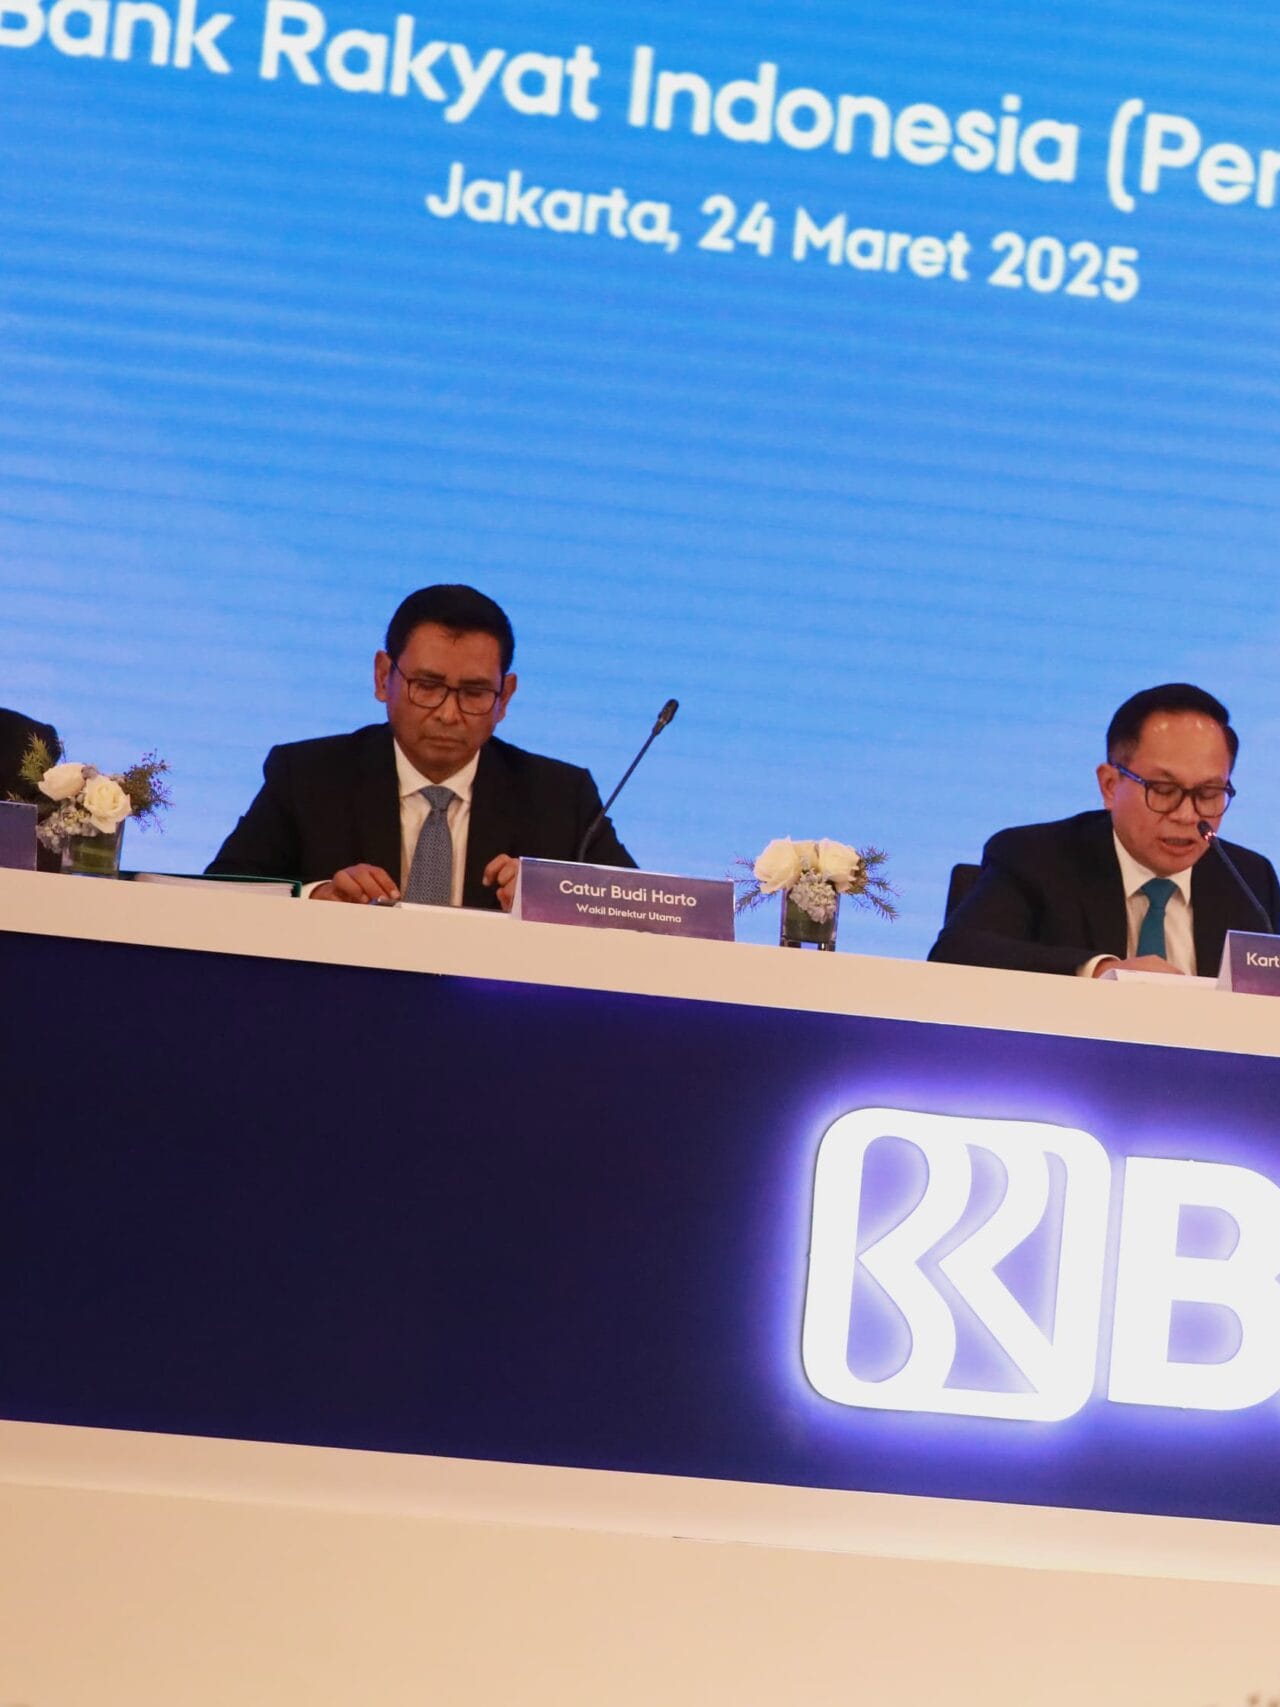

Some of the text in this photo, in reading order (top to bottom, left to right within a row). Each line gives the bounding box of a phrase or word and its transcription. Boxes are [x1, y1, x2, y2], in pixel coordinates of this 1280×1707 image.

[260, 0, 600, 124] Rakyat
[628, 45, 1080, 182] Indonesia
[426, 162, 1139, 303] Jakarta, 24 Maret 2025
[559, 880, 697, 907] Catur Budi Harto
[576, 903, 682, 923] Wakil Direktur Utama
